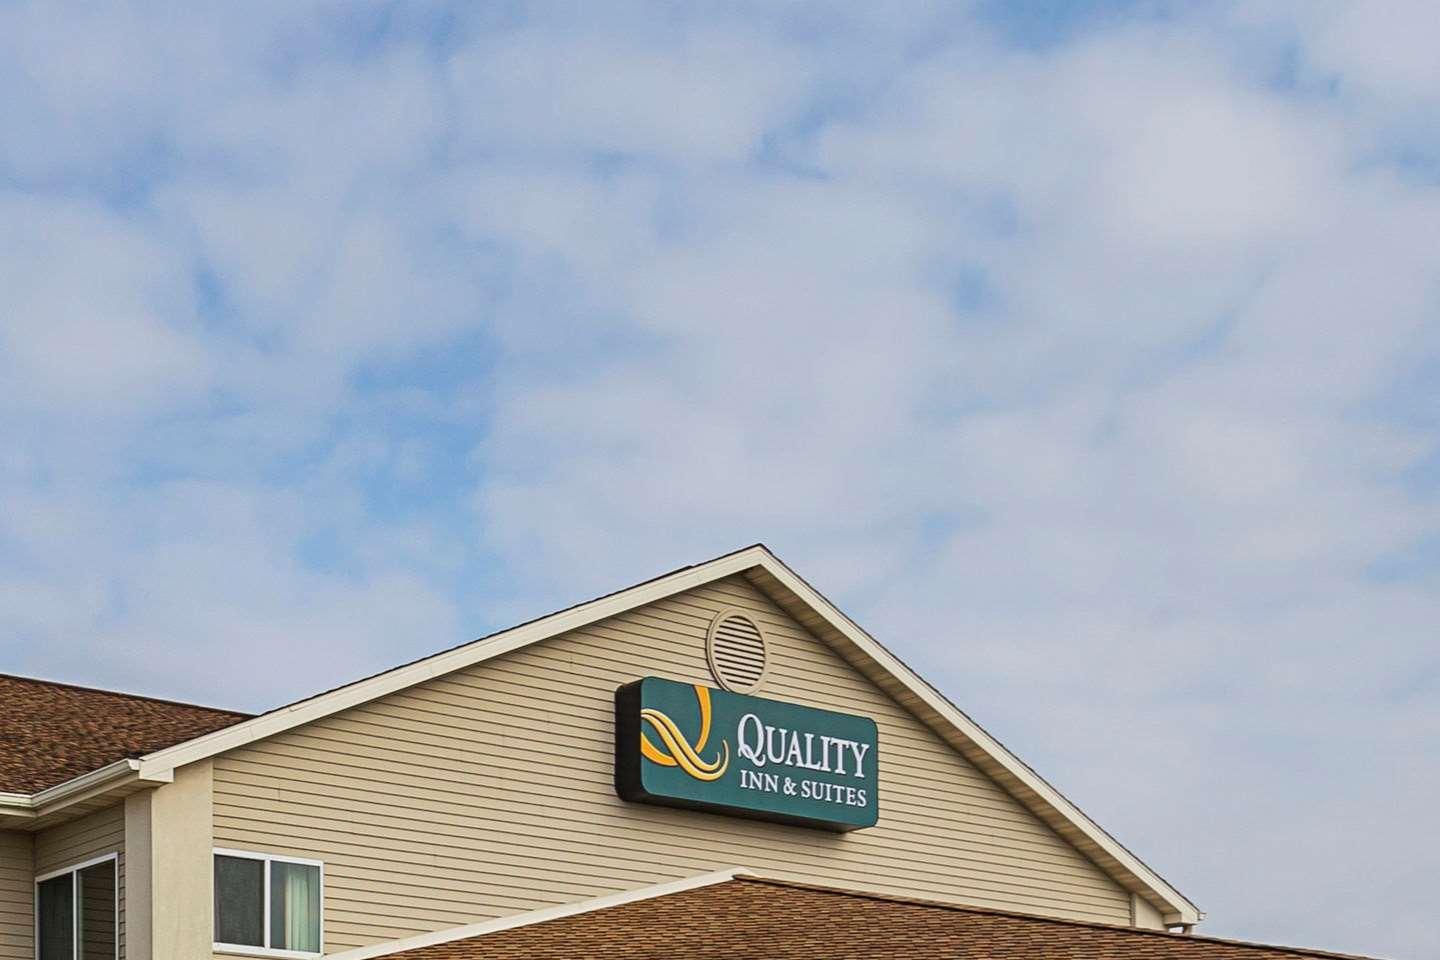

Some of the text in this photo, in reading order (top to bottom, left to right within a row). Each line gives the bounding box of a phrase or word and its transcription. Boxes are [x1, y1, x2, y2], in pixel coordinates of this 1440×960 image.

[737, 713, 870, 778] QUALITY
[740, 769, 867, 807] INN & SUITES
